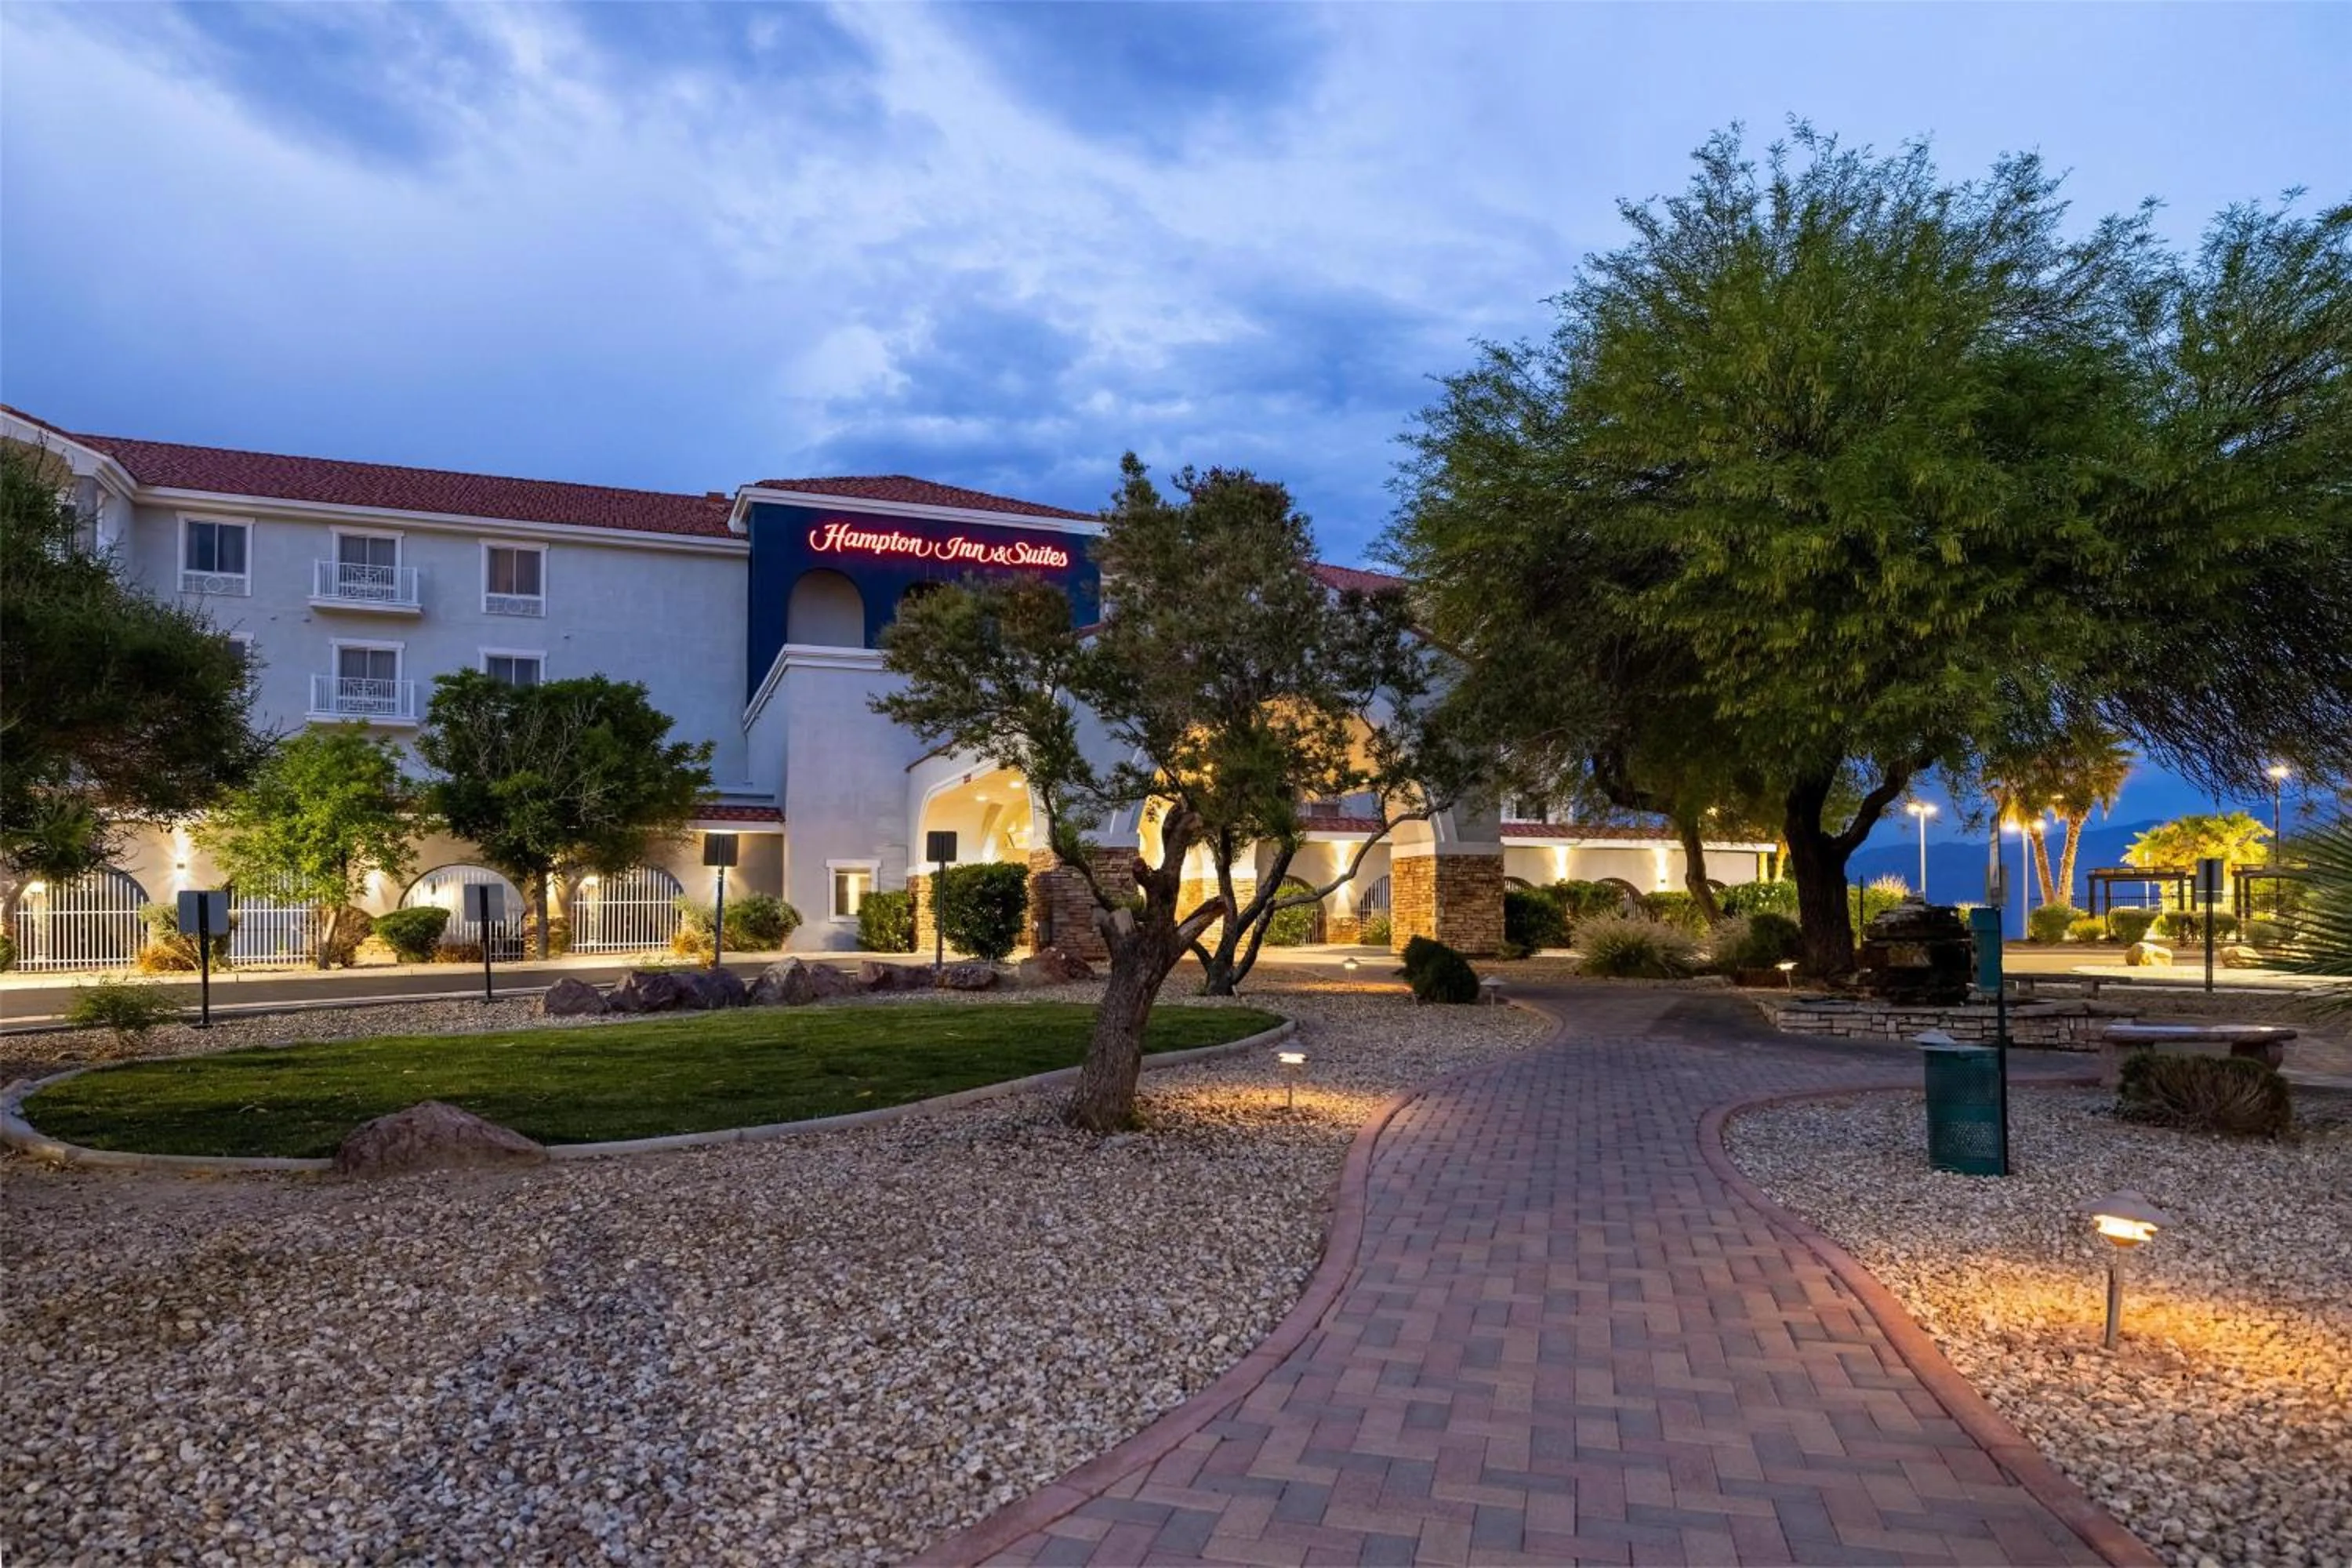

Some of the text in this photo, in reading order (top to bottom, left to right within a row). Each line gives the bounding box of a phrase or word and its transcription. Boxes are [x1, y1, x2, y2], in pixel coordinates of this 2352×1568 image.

[810, 523, 1069, 568] Hampton Inn & Suites
